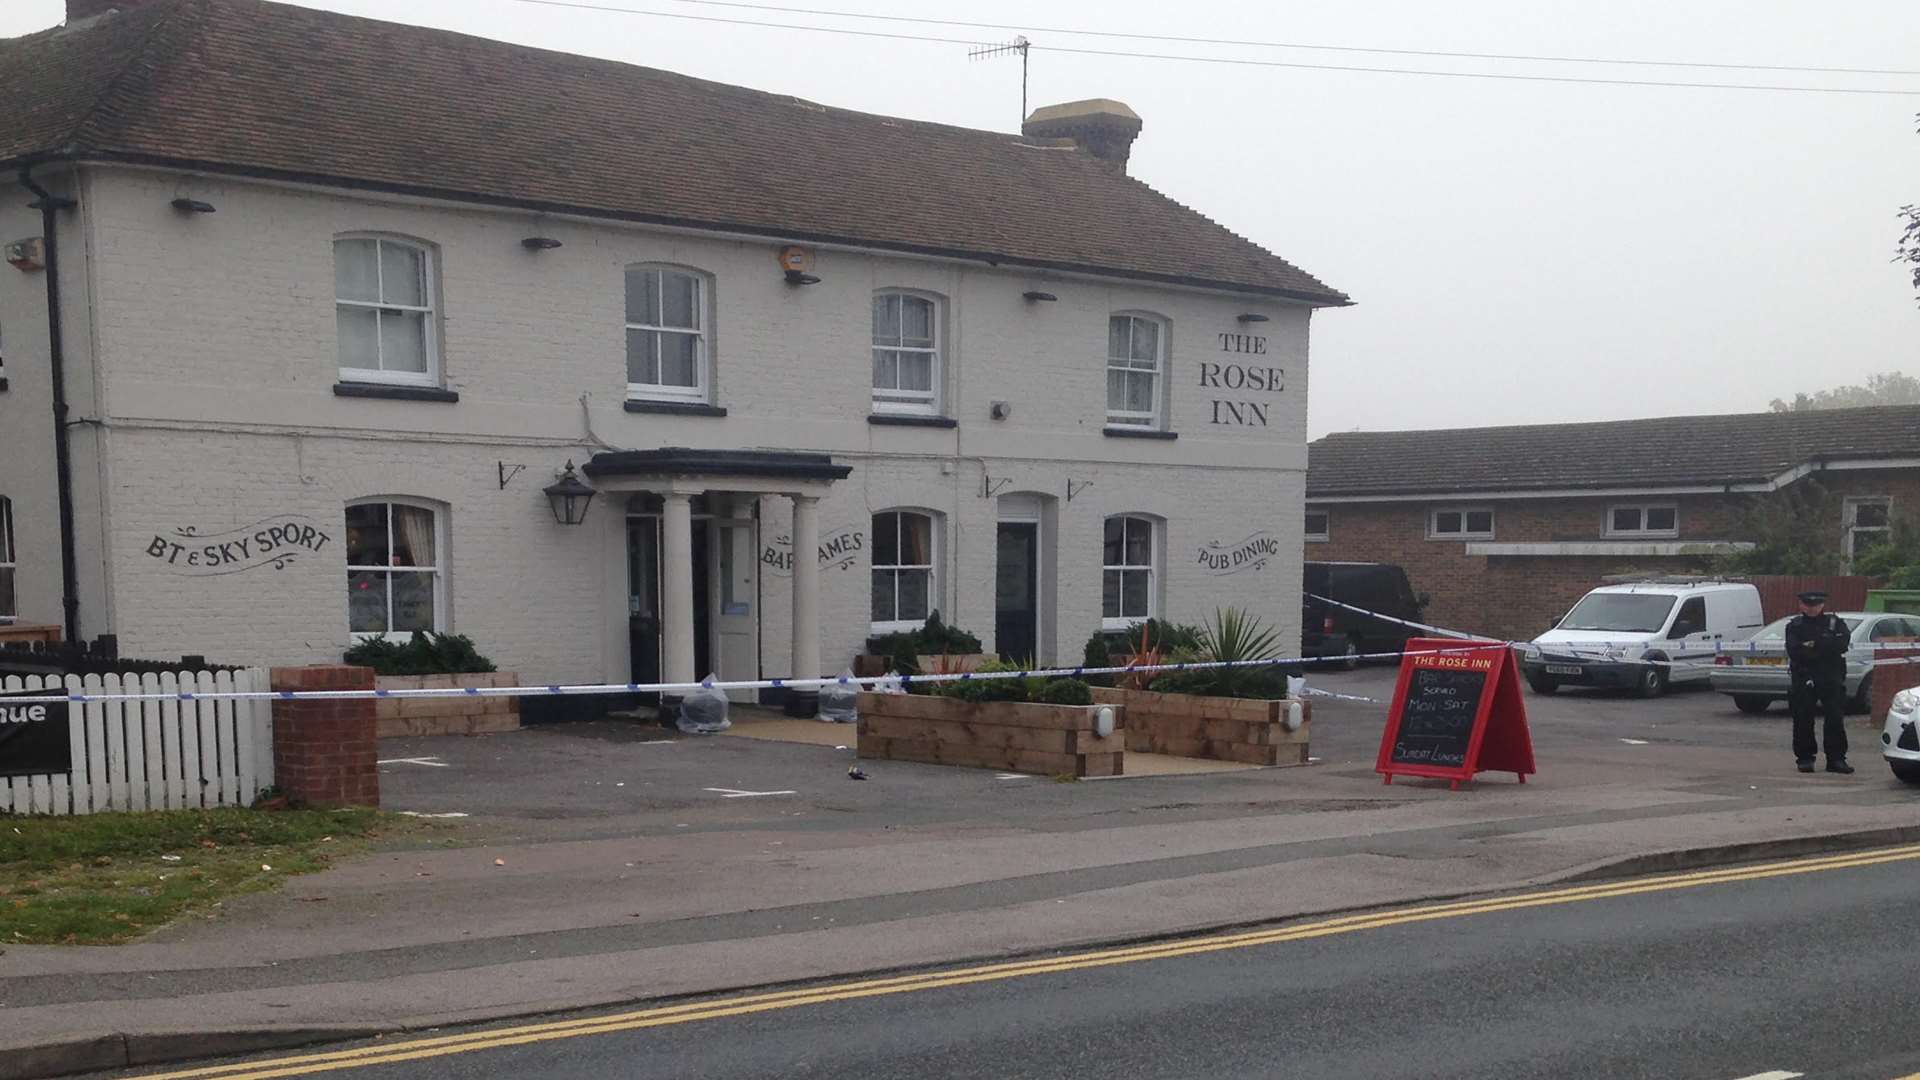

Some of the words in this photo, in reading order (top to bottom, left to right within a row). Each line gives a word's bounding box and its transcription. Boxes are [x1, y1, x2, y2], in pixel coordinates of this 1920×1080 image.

[1218, 333, 1266, 354] THE
[1199, 362, 1285, 392] ROSE
[1210, 400, 1269, 426] INN
[146, 535, 185, 564] BT
[203, 537, 251, 567] SKY
[254, 522, 331, 553] SPORT
[1198, 547, 1230, 569] PUB
[1232, 538, 1279, 566] DINING
[1414, 656, 1435, 666] THE
[1438, 657, 1468, 668] ROSE
[1471, 659, 1492, 669] INN
